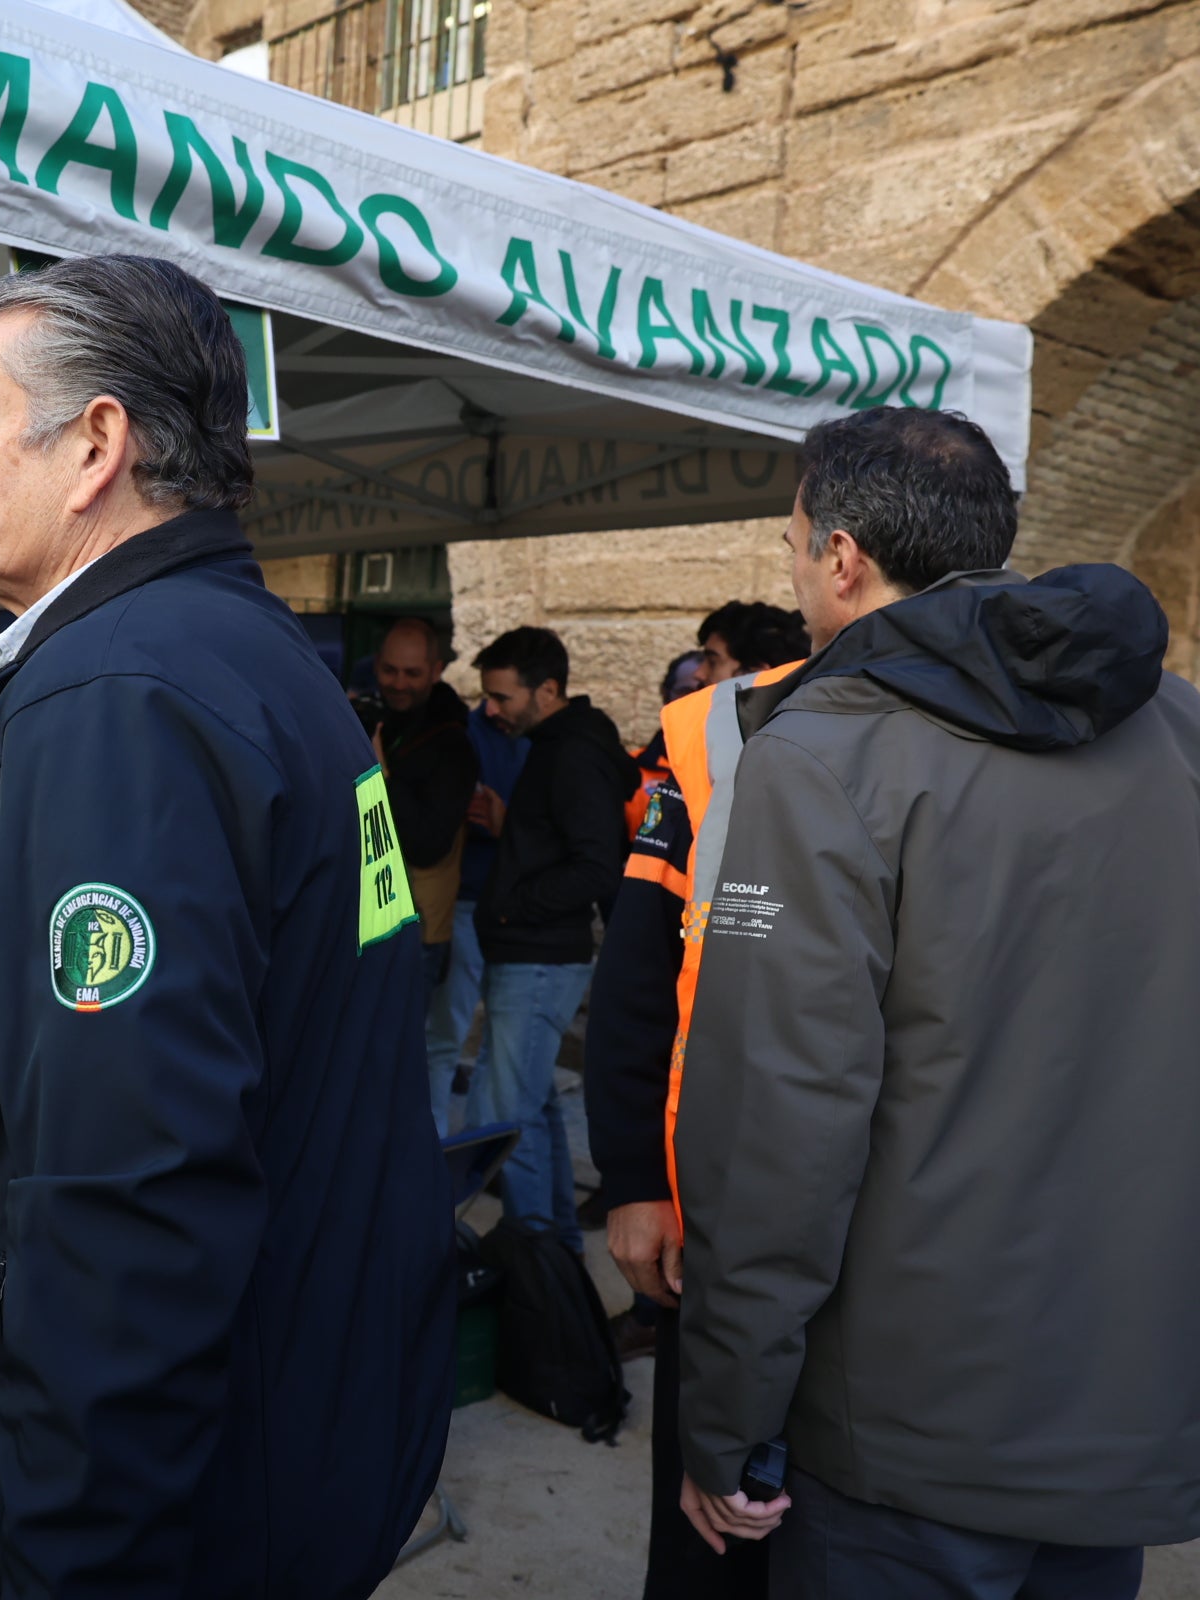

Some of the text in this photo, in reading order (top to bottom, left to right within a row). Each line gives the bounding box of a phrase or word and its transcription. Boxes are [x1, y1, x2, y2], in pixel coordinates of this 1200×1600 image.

[495, 237, 953, 411] AVANZADO
[363, 800, 394, 866] EMA
[374, 864, 397, 909] 112
[722, 882, 769, 895] ECOALF
[63, 892, 122, 917] EMERGENCIAS
[118, 904, 133, 920] DE
[128, 917, 146, 969] ANDALUCÍA
[76, 987, 100, 1002] EMA
